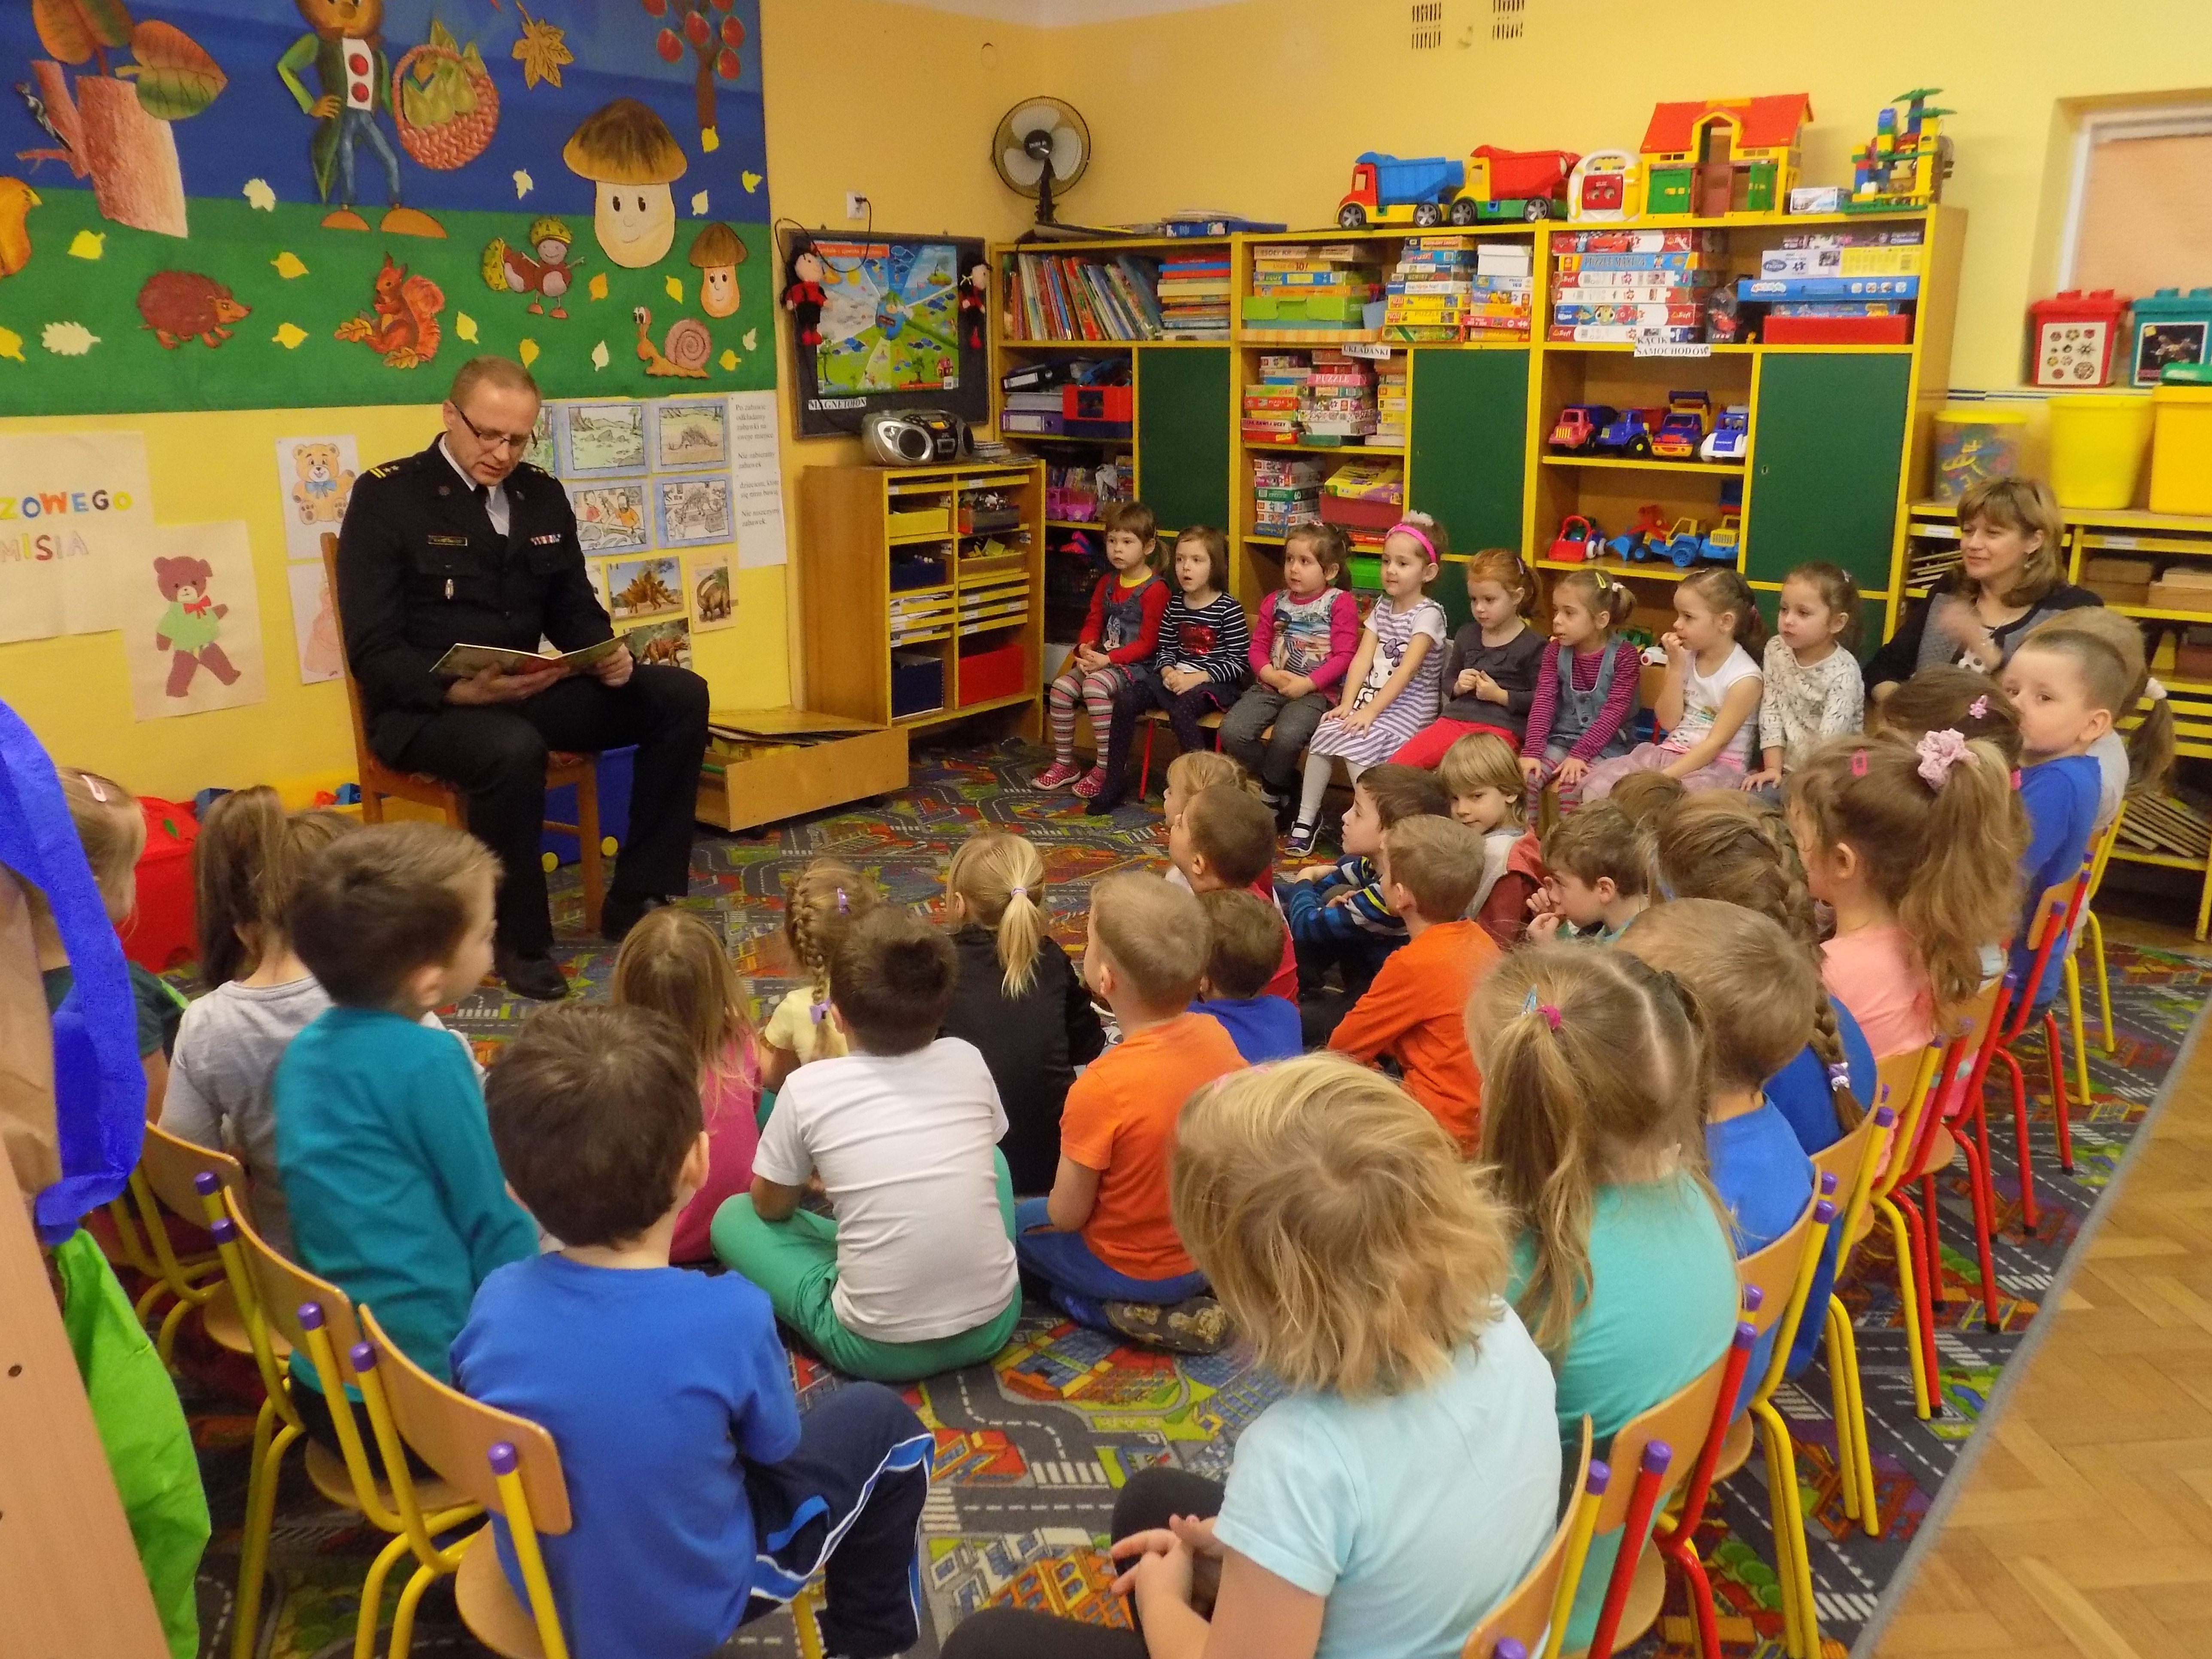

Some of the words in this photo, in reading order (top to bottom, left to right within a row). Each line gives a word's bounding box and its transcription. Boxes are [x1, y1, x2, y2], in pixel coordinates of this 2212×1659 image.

[1638, 337, 1667, 345] KĄCIK
[1636, 345, 1709, 355] SAMOCHODÓW
[1315, 375, 1349, 383] PUZZLE
[1294, 491, 1302, 500] 60
[0, 489, 133, 520] ZOWEGO
[0, 530, 89, 562] MISIA
